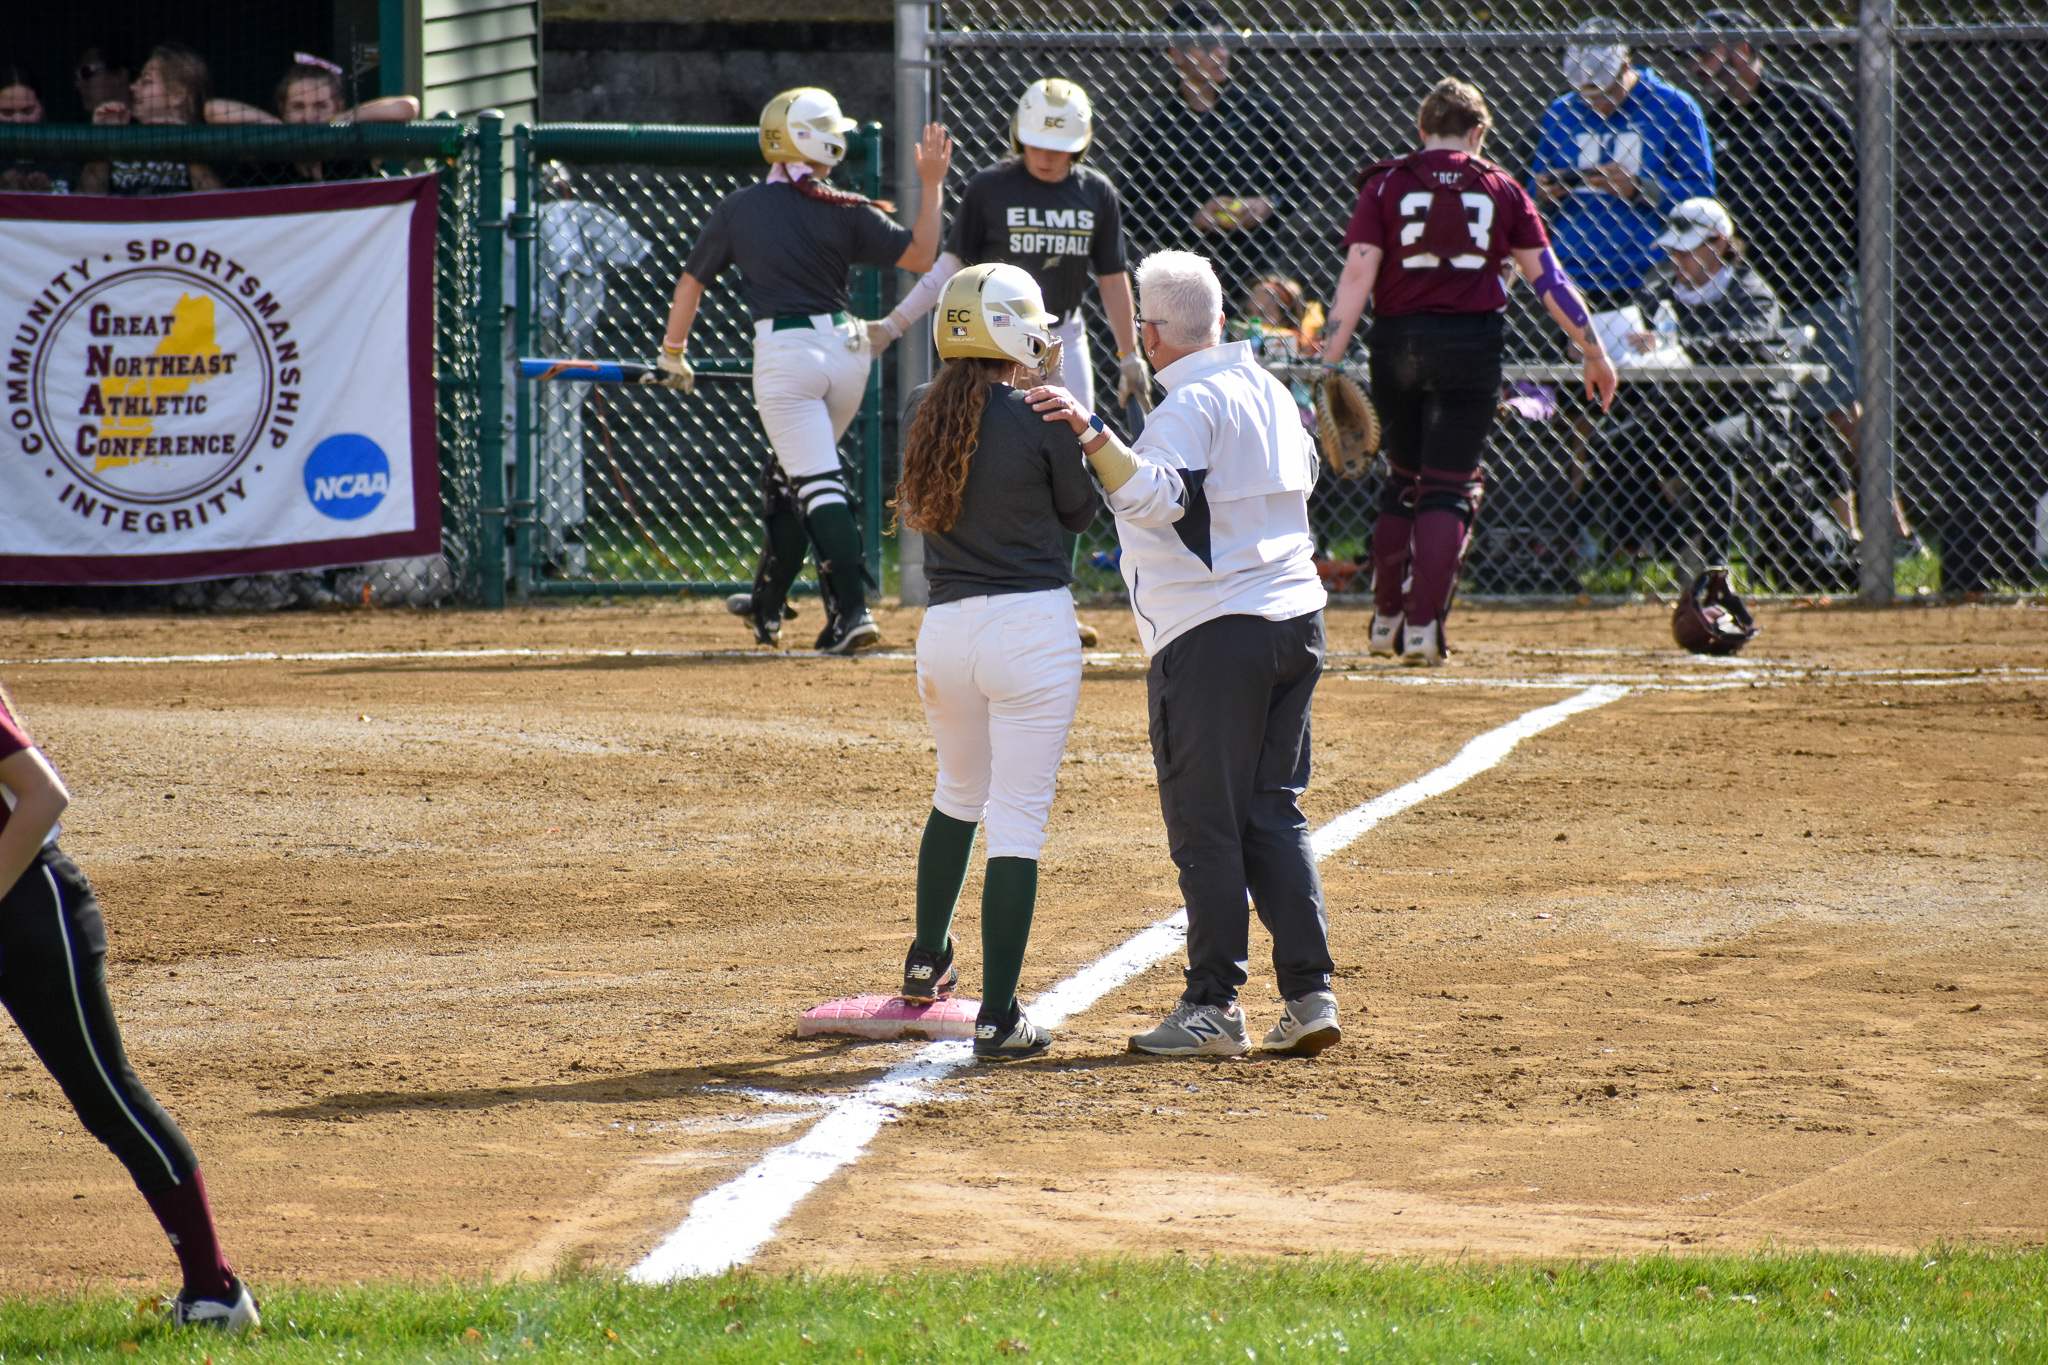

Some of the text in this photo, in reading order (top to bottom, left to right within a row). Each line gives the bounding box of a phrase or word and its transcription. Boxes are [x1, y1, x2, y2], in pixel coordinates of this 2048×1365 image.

[1045, 116, 1065, 128] EC
[765, 130, 781, 140] EC
[1007, 207, 1094, 229] ELMS
[1009, 234, 1089, 255] SOFTBALL
[947, 309, 970, 323] EC
[126, 239, 302, 449] SPORTSMANSHIP
[7, 258, 92, 455] COMMUNITY
[313, 472, 390, 500] NCAA
[59, 478, 247, 533] INTEGRITY
[1186, 1017, 1221, 1043] N
